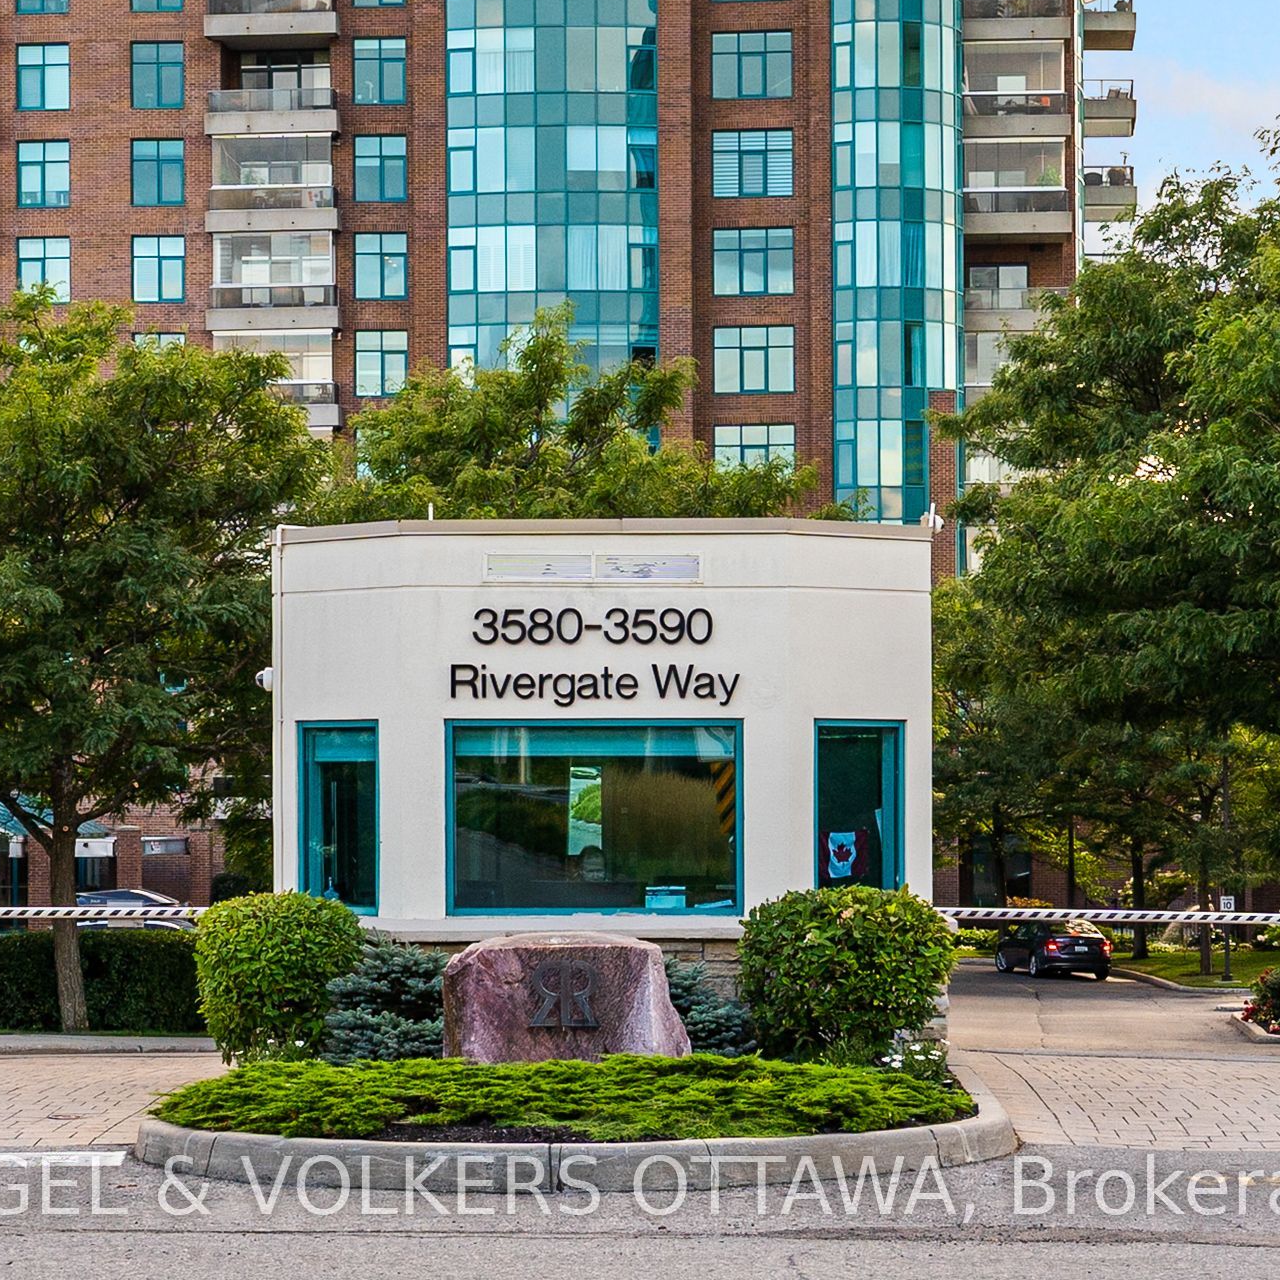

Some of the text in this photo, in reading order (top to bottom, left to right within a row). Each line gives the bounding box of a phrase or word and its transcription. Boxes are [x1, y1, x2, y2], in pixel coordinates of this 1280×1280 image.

[472, 607, 714, 646] 3580-3590
[450, 663, 741, 708] Rivergate Way
[1223, 901, 1232, 910] 10
